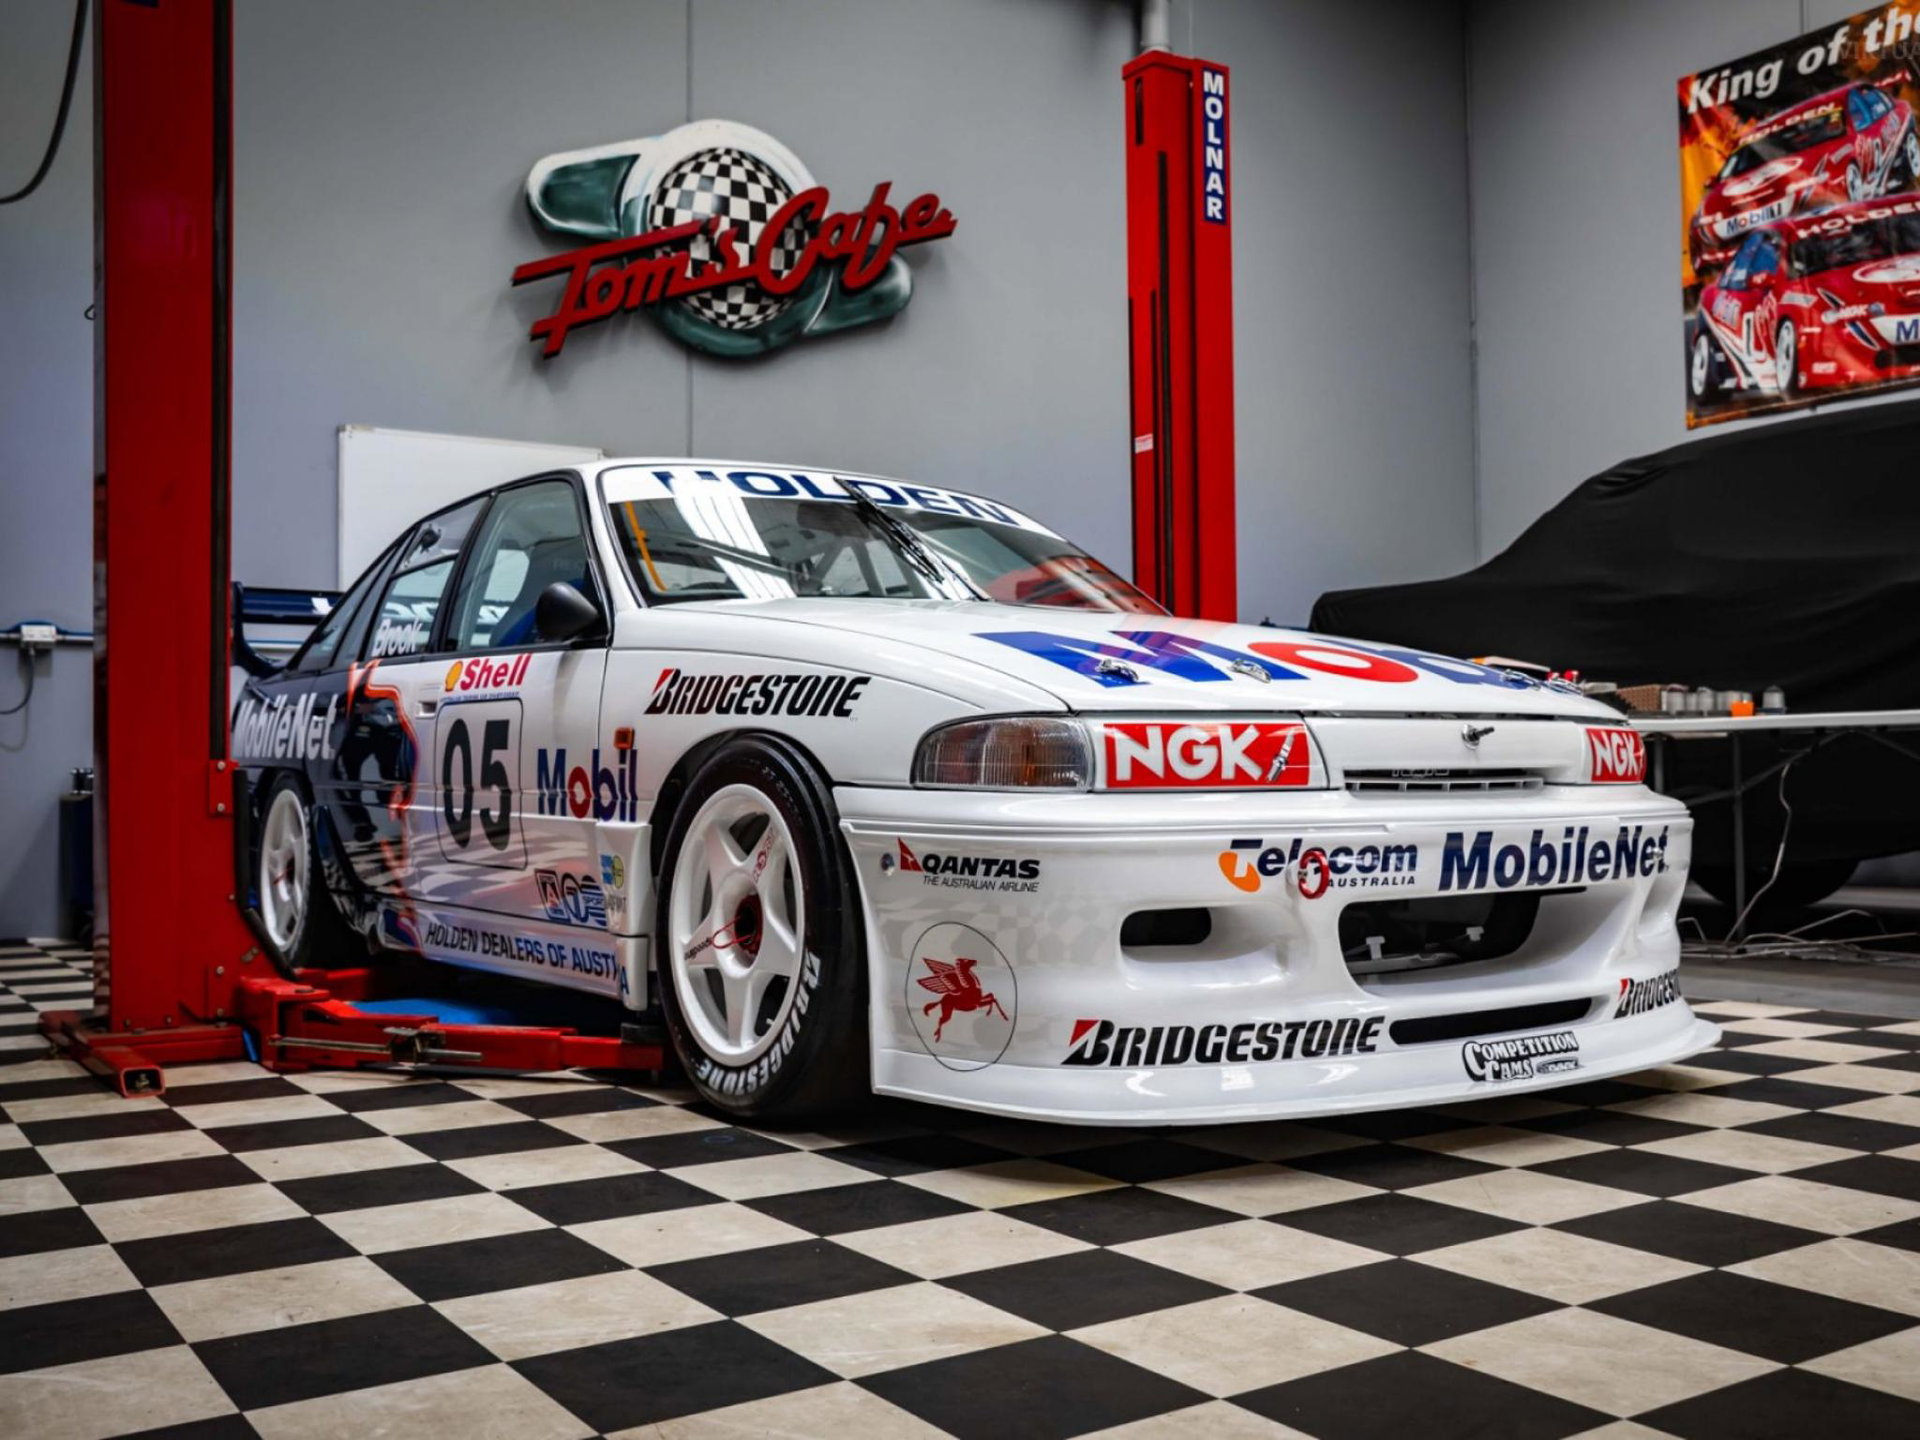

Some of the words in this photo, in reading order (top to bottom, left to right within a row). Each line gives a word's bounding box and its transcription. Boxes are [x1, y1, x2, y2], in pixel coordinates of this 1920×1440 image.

[1688, 60, 1783, 114] King
[1798, 25, 1849, 75] of
[1203, 71, 1224, 219] MOLNAR
[512, 217, 741, 357] Tom's
[460, 653, 532, 690] Shell
[644, 668, 871, 717] BRIDGESTONE
[231, 692, 339, 761] MobileNet
[1113, 725, 1264, 781] NGK
[1592, 730, 1641, 778] NGK
[442, 718, 511, 852] 05
[536, 748, 638, 822] Mobil
[922, 853, 1040, 880] QANTAS
[923, 875, 939, 886] THE
[942, 877, 996, 891] AUSTRALIAN
[999, 881, 1040, 892] AIRLINE
[1438, 825, 1668, 892] MobileNet
[425, 922, 478, 952] HOLDEN
[482, 932, 545, 964] DEALERS
[549, 943, 567, 969] OF
[1062, 1016, 1385, 1066] BRIDGESTONE
